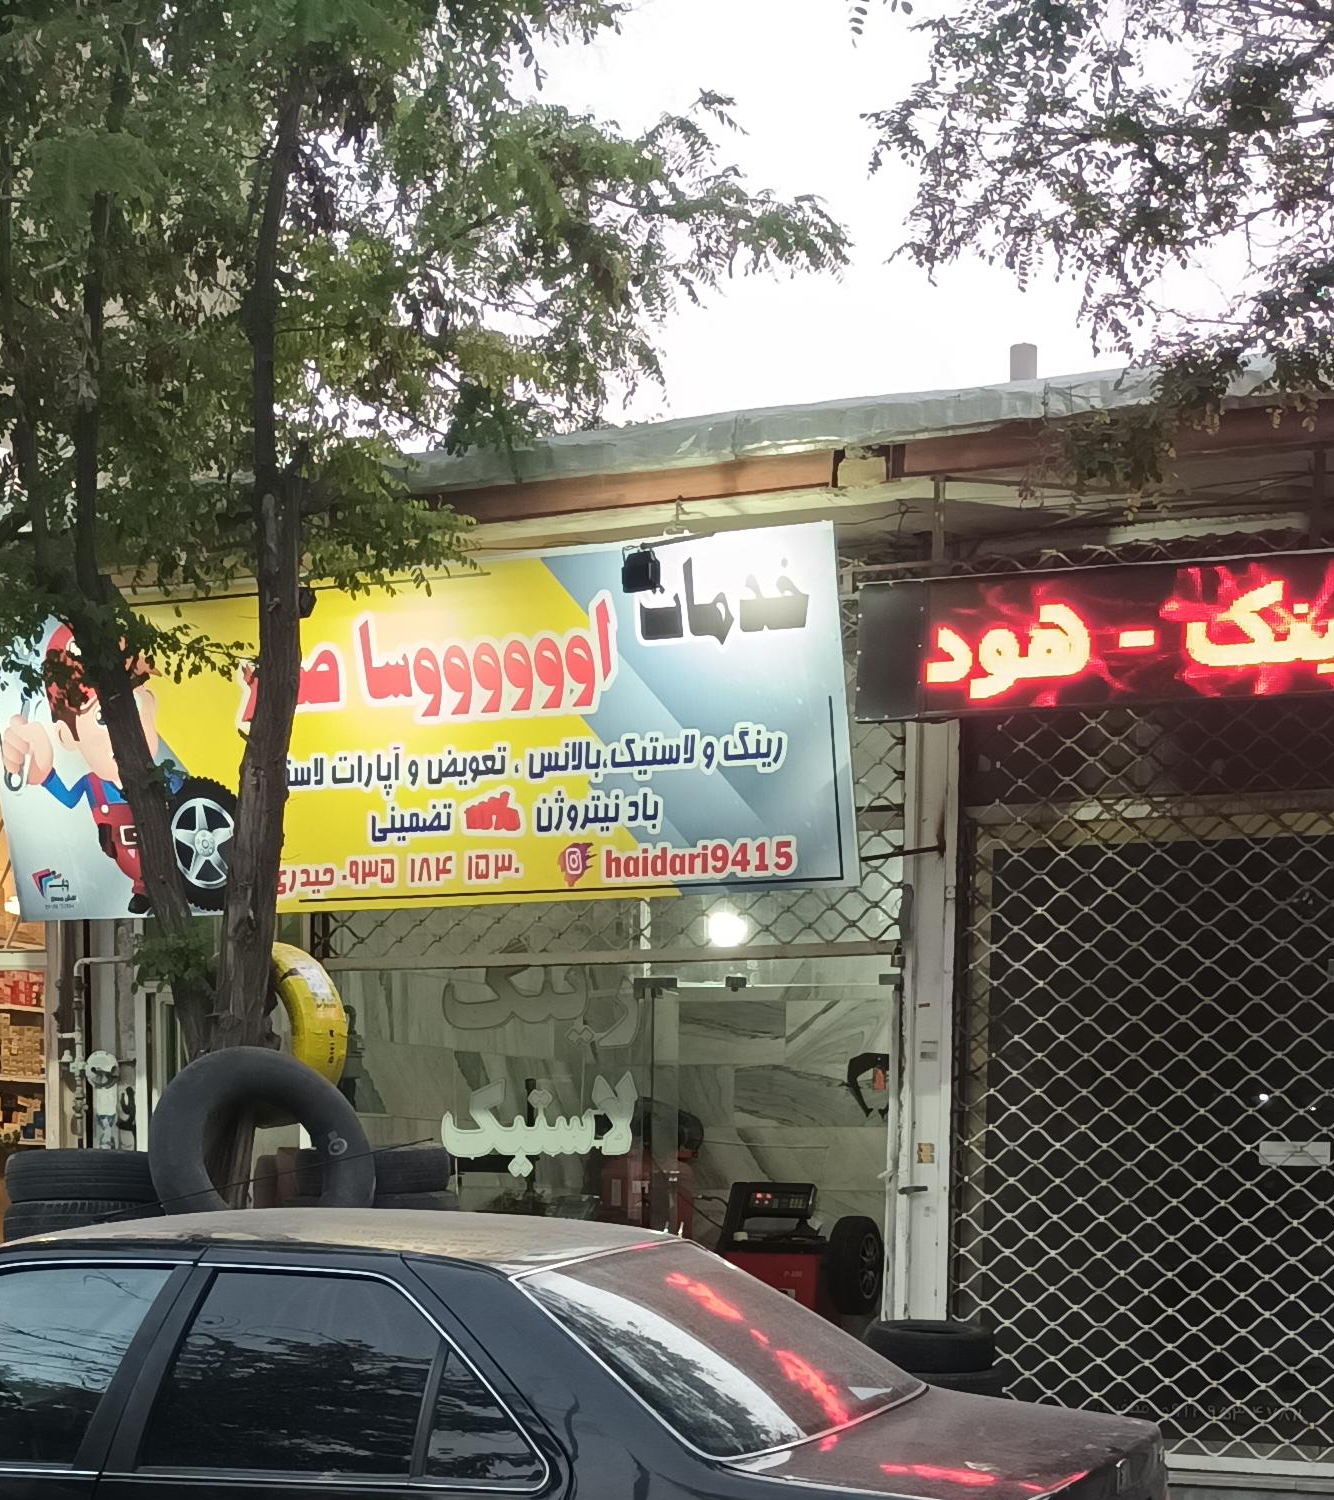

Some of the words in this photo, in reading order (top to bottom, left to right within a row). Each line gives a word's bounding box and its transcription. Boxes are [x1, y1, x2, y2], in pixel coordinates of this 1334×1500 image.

[639, 556, 810, 646] خدمات
[924, 602, 1092, 700] هود
[427, 745, 507, 786] تعویض
[702, 740, 716, 770] و
[723, 726, 785, 768] رینگ
[331, 746, 401, 796] آپارات
[408, 758, 419, 786] و
[371, 802, 452, 843] تضمینی
[536, 790, 620, 833] نیتروژن
[627, 792, 659, 830] باد
[410, 855, 453, 883] ۱۸۴
[604, 840, 794, 878] haidari9415
[441, 1070, 639, 1178] لاستیک
